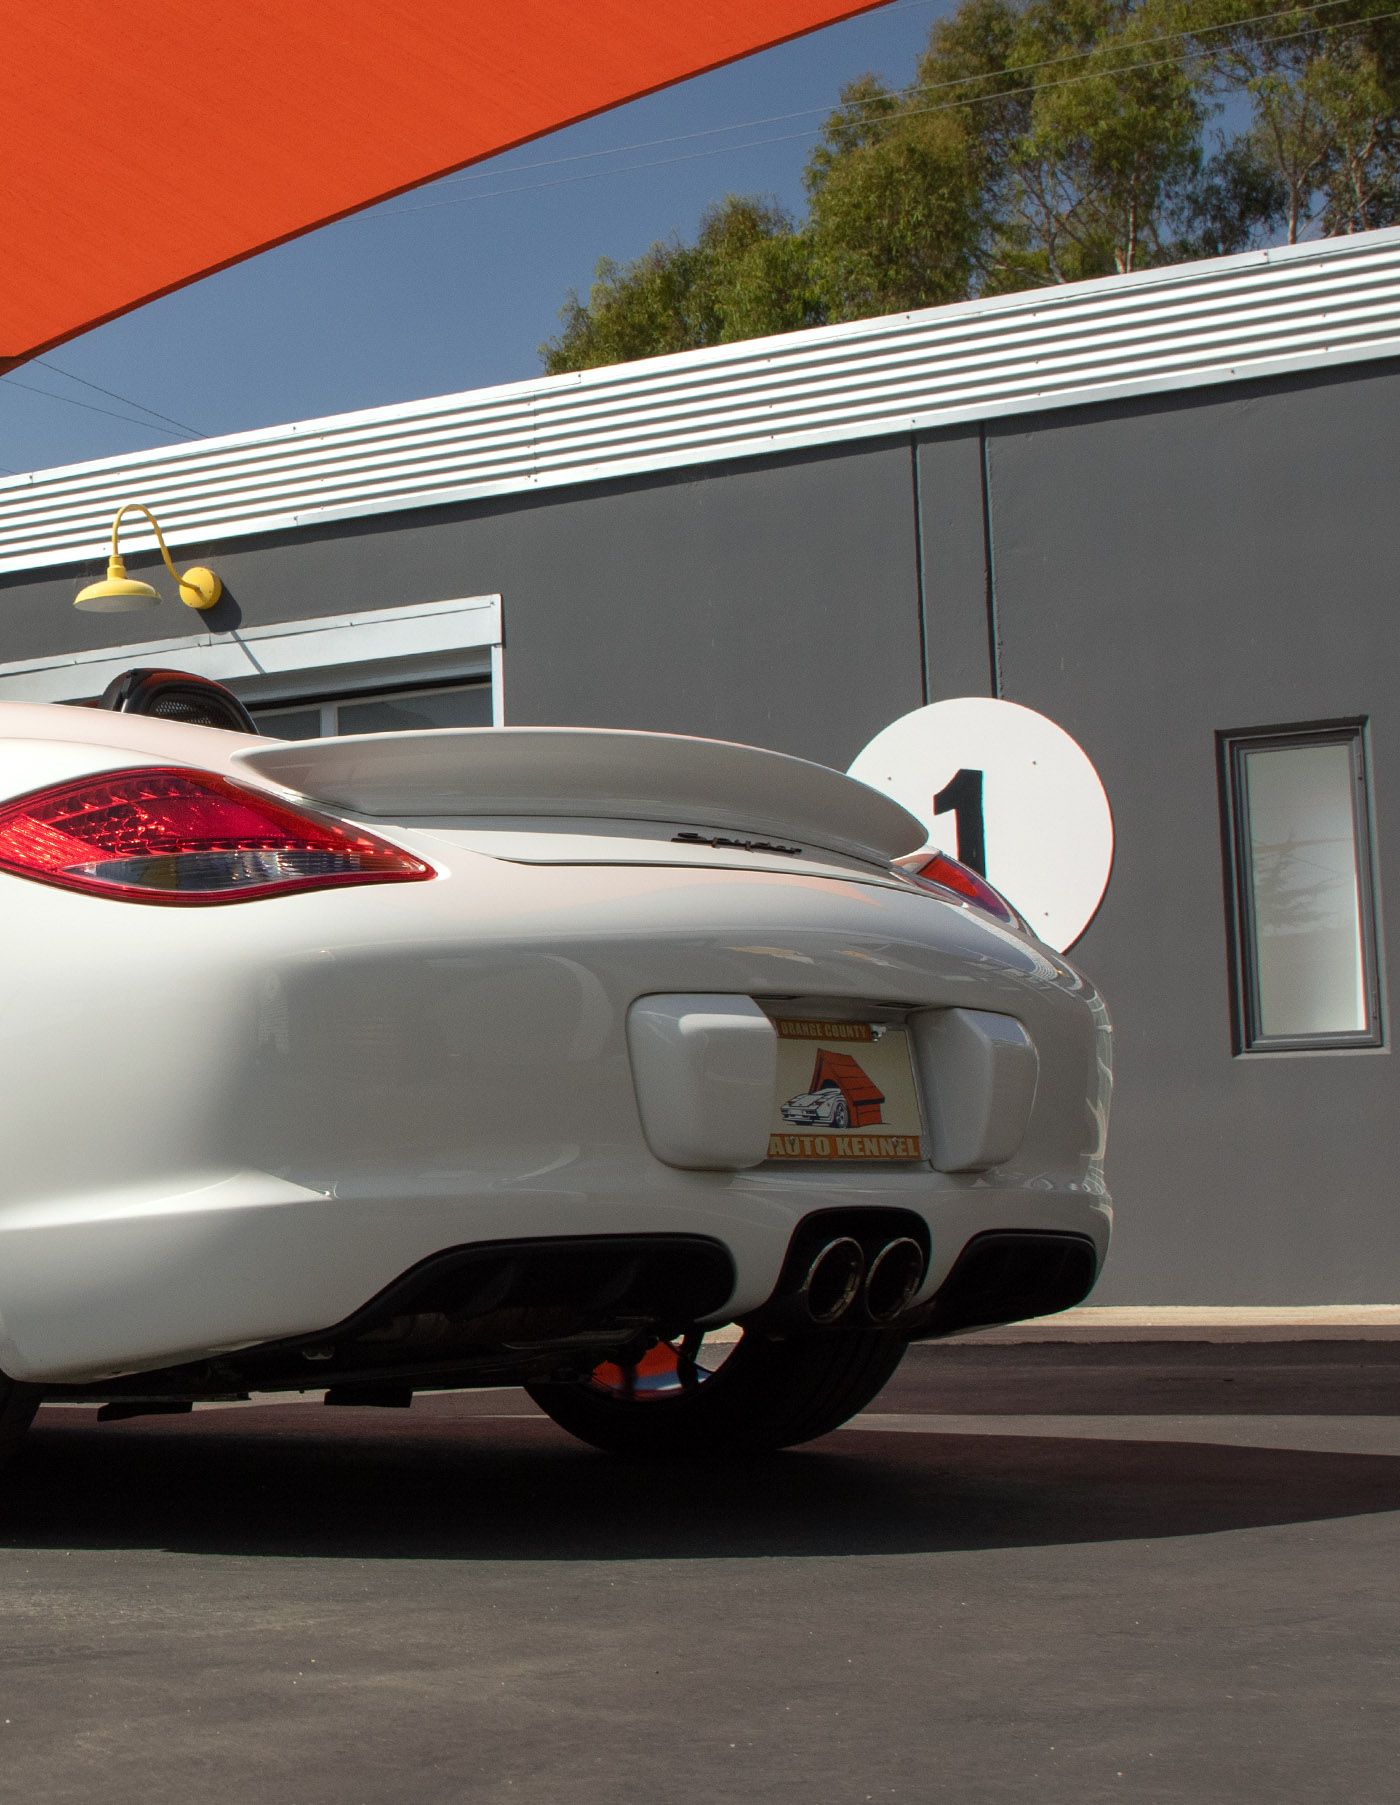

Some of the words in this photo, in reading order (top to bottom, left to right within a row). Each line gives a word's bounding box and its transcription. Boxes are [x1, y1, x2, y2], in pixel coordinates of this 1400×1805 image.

[933, 768, 987, 880] 1
[780, 1021, 823, 1037] ORANGE
[824, 1023, 868, 1039] COUNTY
[769, 1136, 830, 1156] AUTO
[835, 1137, 919, 1156] KENNEL
